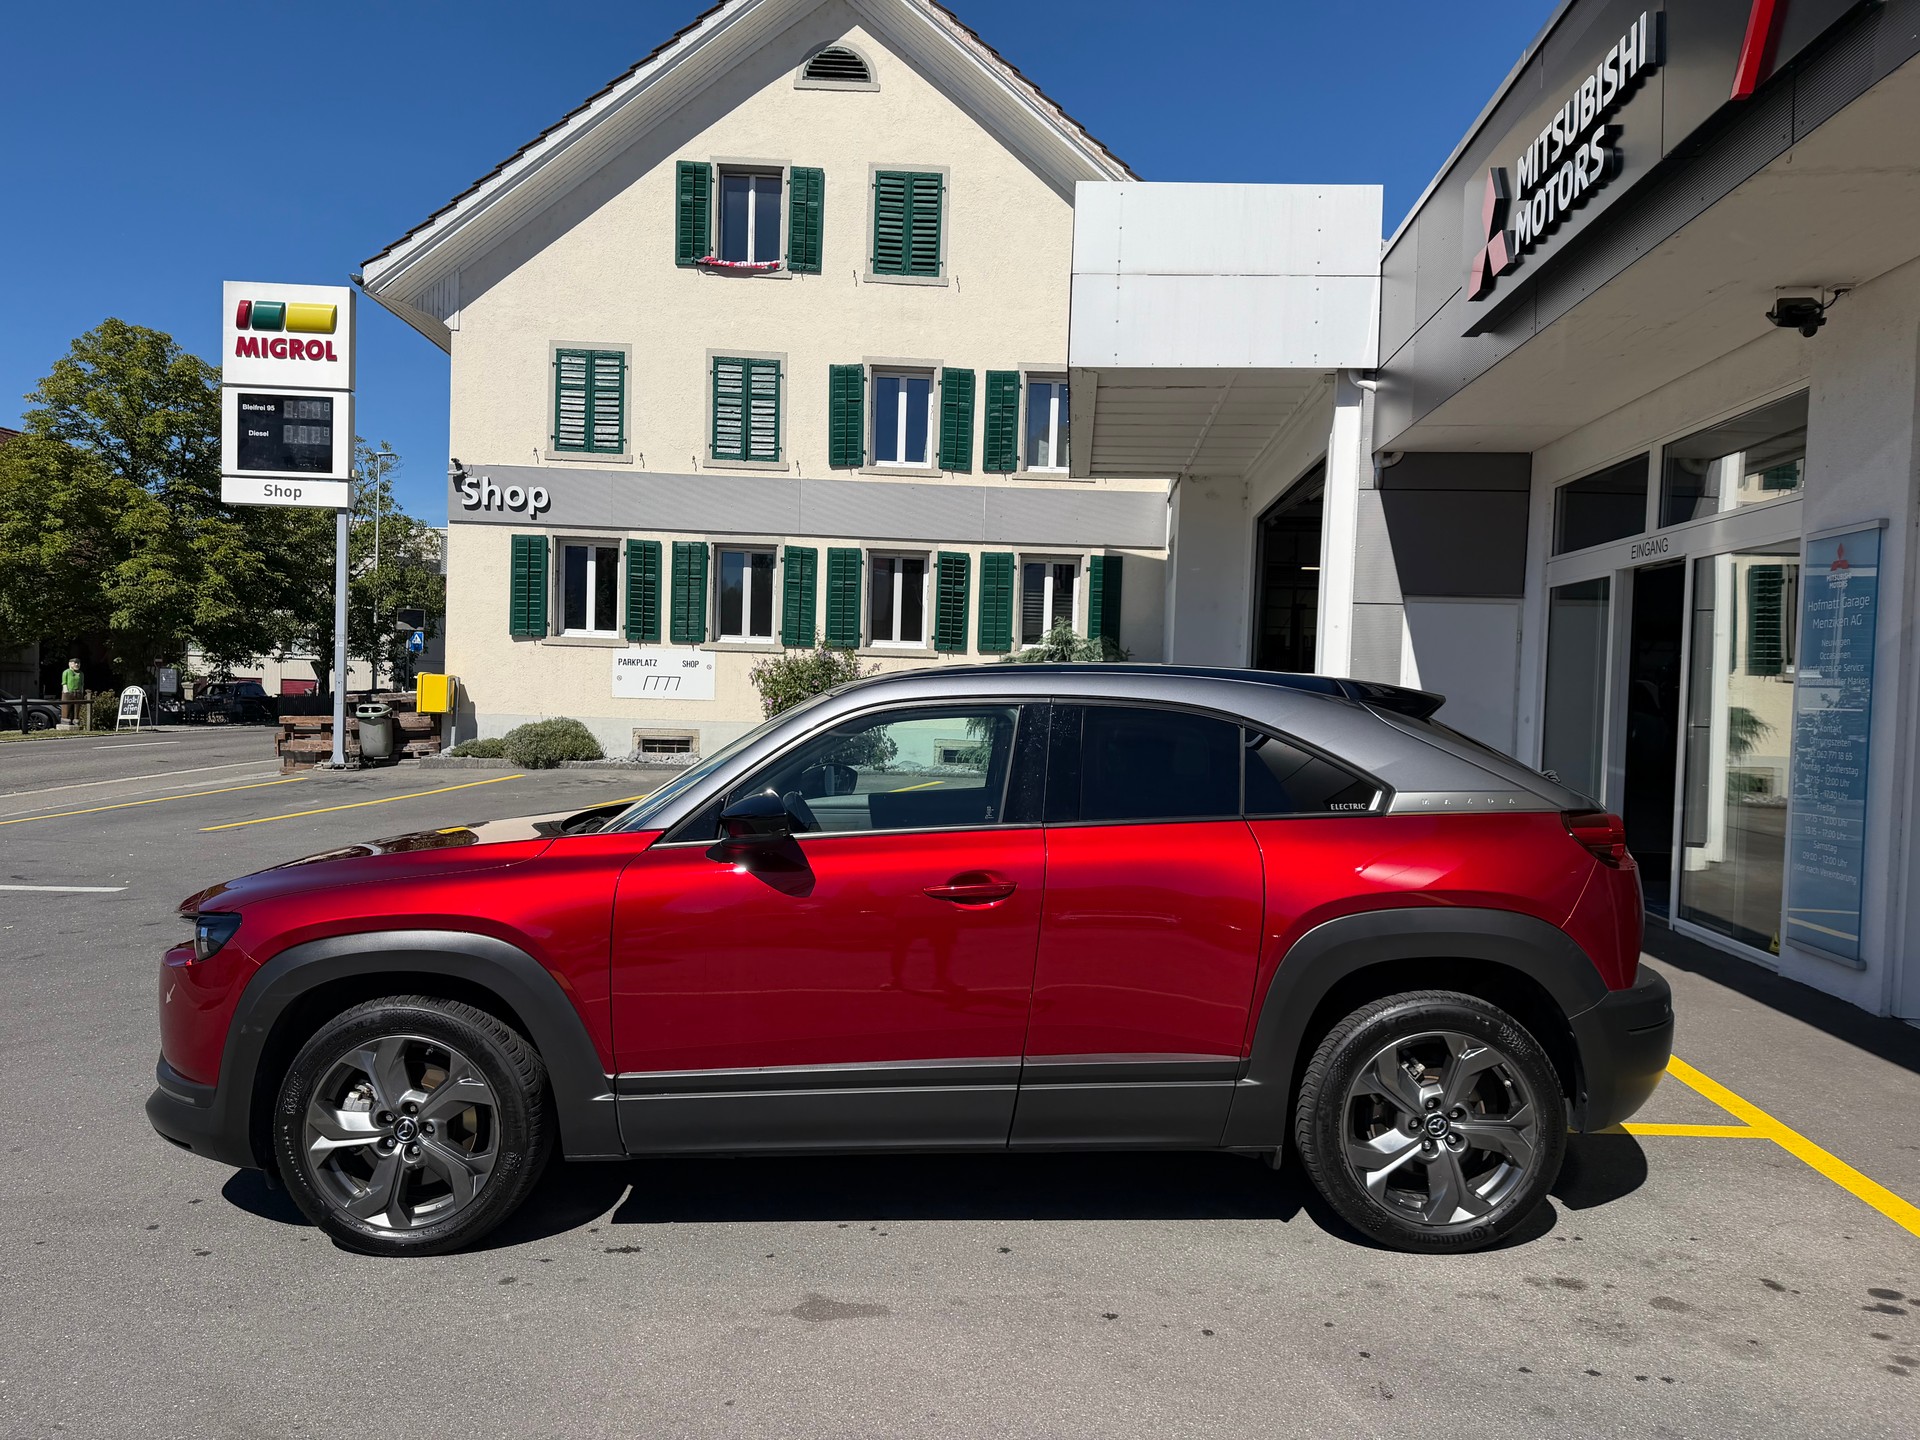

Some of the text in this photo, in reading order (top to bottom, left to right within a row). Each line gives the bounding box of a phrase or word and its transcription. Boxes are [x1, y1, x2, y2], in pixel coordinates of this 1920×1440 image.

[1516, 11, 1648, 202] MITSUBISHI
[1515, 124, 1606, 256] MOTORS
[235, 336, 338, 362] MIGROL
[242, 403, 266, 411] Bleifrei
[248, 429, 269, 437] Diesel
[263, 484, 302, 501] Shop
[461, 476, 550, 517] Shop
[1631, 537, 1669, 560] EINGANG
[1826, 572, 1852, 582] MITSUBISHI
[1828, 580, 1848, 589] MOTORS
[1807, 595, 1871, 612] Hofmatt Garage
[1812, 613, 1863, 629] Menziken AG
[617, 658, 700, 668] PARKPLATZ SHOP
[1843, 662, 1865, 672] Service
[1800, 761, 1821, 774] Montag
[1825, 763, 1860, 778] Donnerstag
[1330, 803, 1367, 811] ELECTRIC
[1816, 801, 1837, 815] Freitag
[1813, 840, 1838, 855] Samstag
